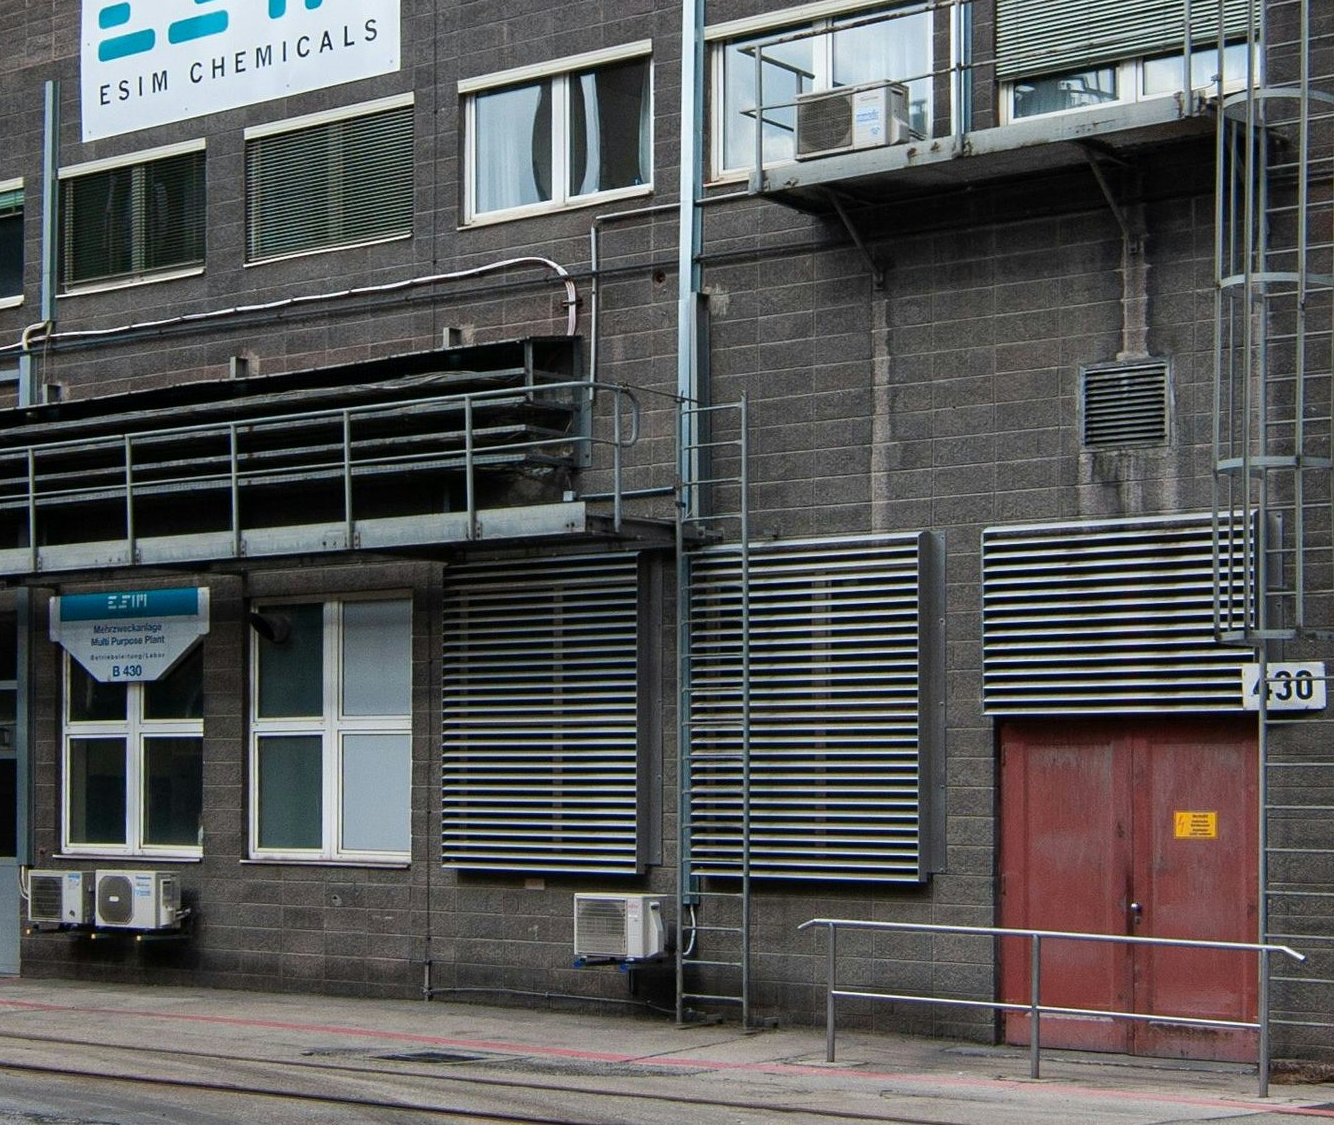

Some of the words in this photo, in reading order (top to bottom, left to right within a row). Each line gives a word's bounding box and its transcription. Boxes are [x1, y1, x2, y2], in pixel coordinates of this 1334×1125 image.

[99, 70, 169, 106] ESIM
[189, 19, 379, 85] CHEMICALS
[107, 594, 147, 610] ESIM
[93, 623, 162, 634] Mehrzweckanlage
[91, 637, 110, 647] Multi
[111, 637, 143, 647] Purpose
[145, 635, 165, 645] Plant
[112, 666, 120, 677] B
[123, 664, 142, 677] 430
